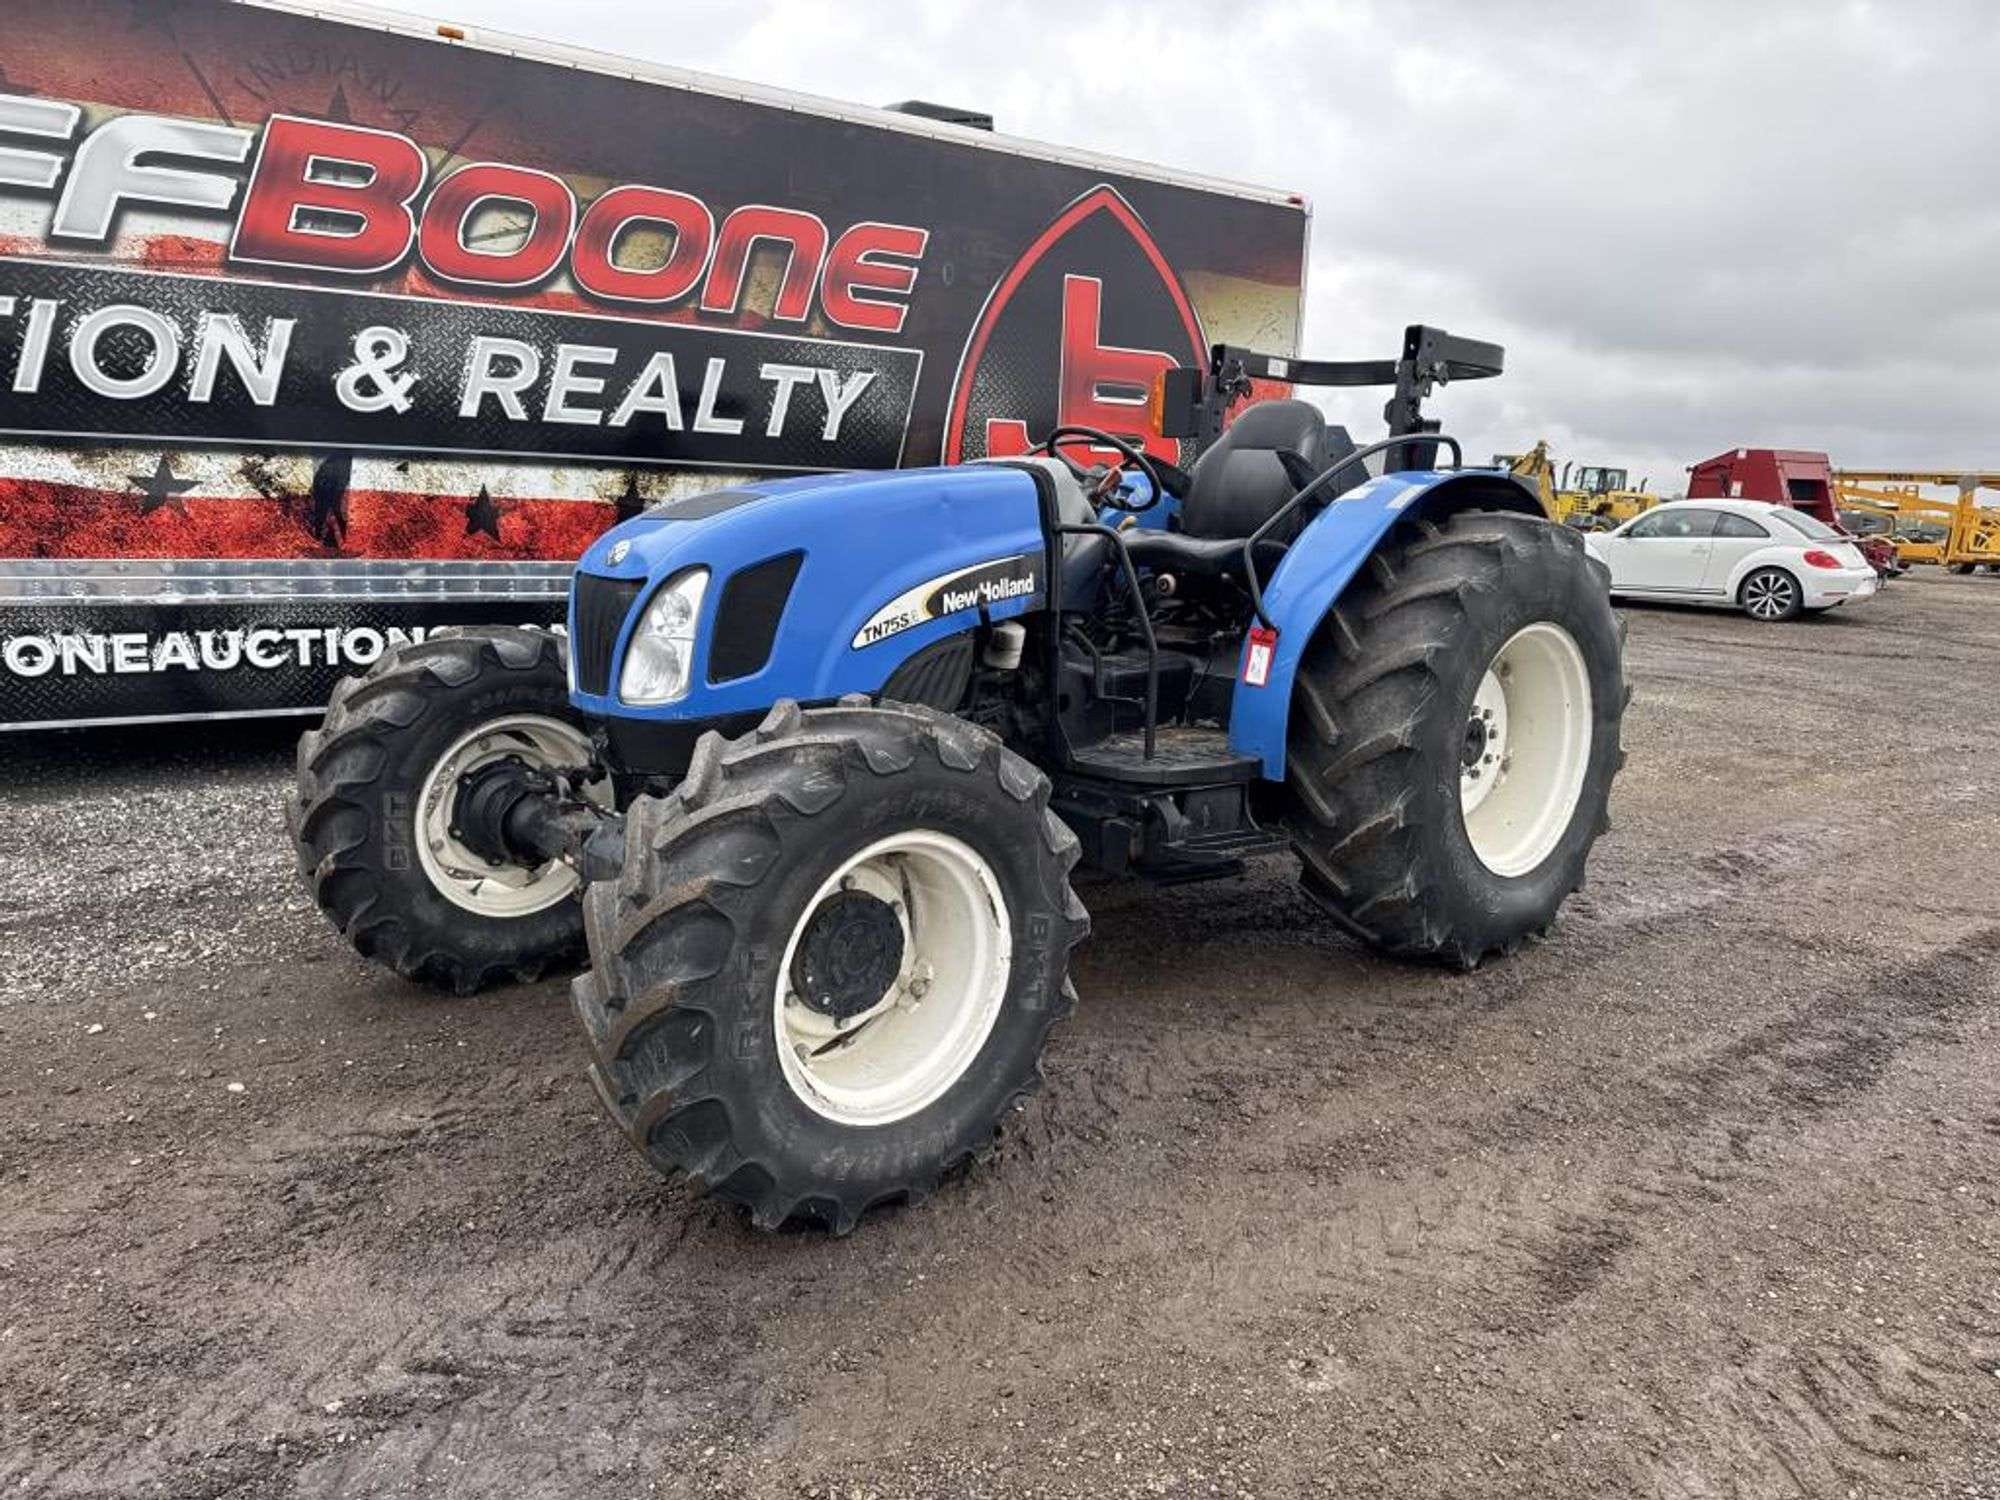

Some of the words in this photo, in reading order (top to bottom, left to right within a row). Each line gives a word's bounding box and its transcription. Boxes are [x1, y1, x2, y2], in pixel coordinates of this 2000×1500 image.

[234, 46, 421, 131] INDIANA
[0, 295, 297, 406] ION
[335, 326, 419, 412] &
[457, 334, 878, 441] REALTY
[943, 589, 978, 615] New
[979, 571, 1034, 602] Holland
[5, 624, 450, 678] ONEAUCTION
[864, 609, 919, 642] TN75S
